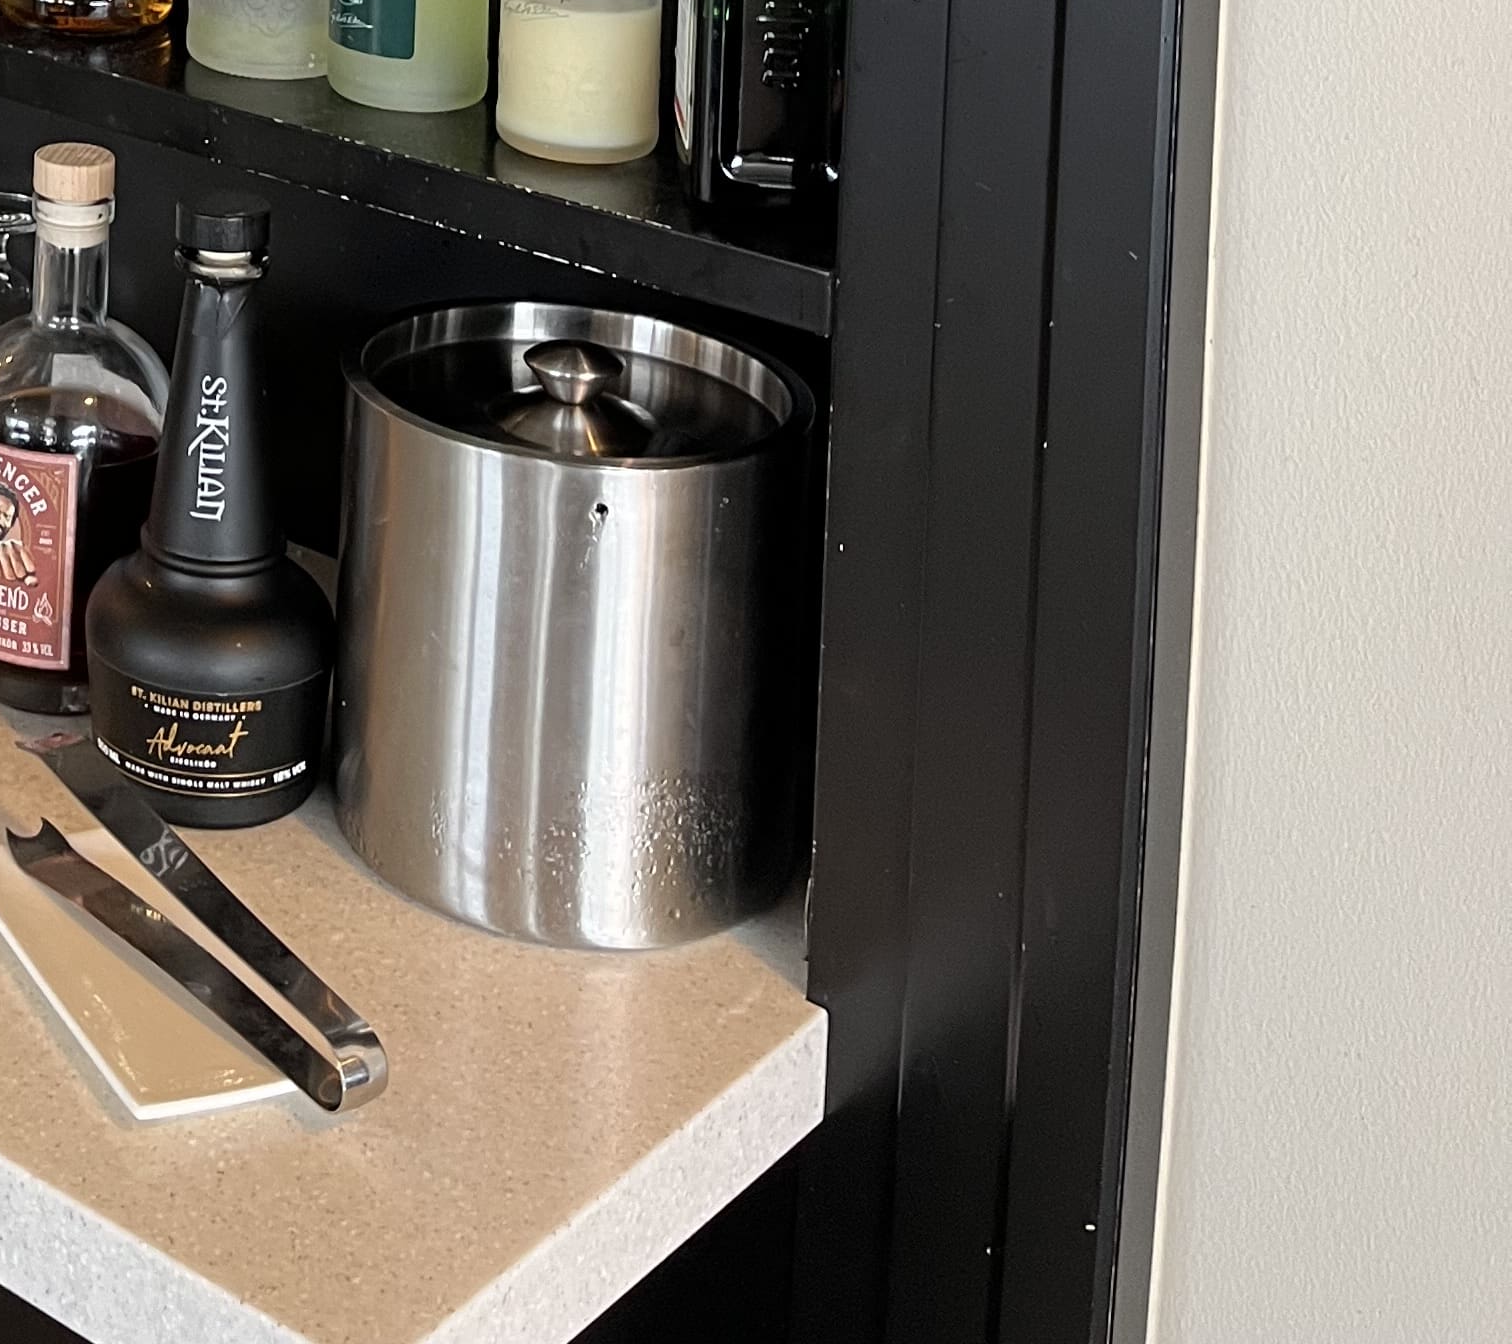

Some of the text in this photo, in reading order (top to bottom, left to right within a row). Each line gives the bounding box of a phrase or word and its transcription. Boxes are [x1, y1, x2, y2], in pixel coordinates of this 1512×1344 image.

[131, 685, 262, 713] ST. KILIAN DISTILLERS
[153, 706, 177, 716] MADE
[192, 712, 236, 721] GERMANY
[146, 720, 248, 760] Advocaat
[148, 769, 169, 782] WITH
[171, 776, 203, 789] SINGLE
[206, 780, 230, 789] MALT
